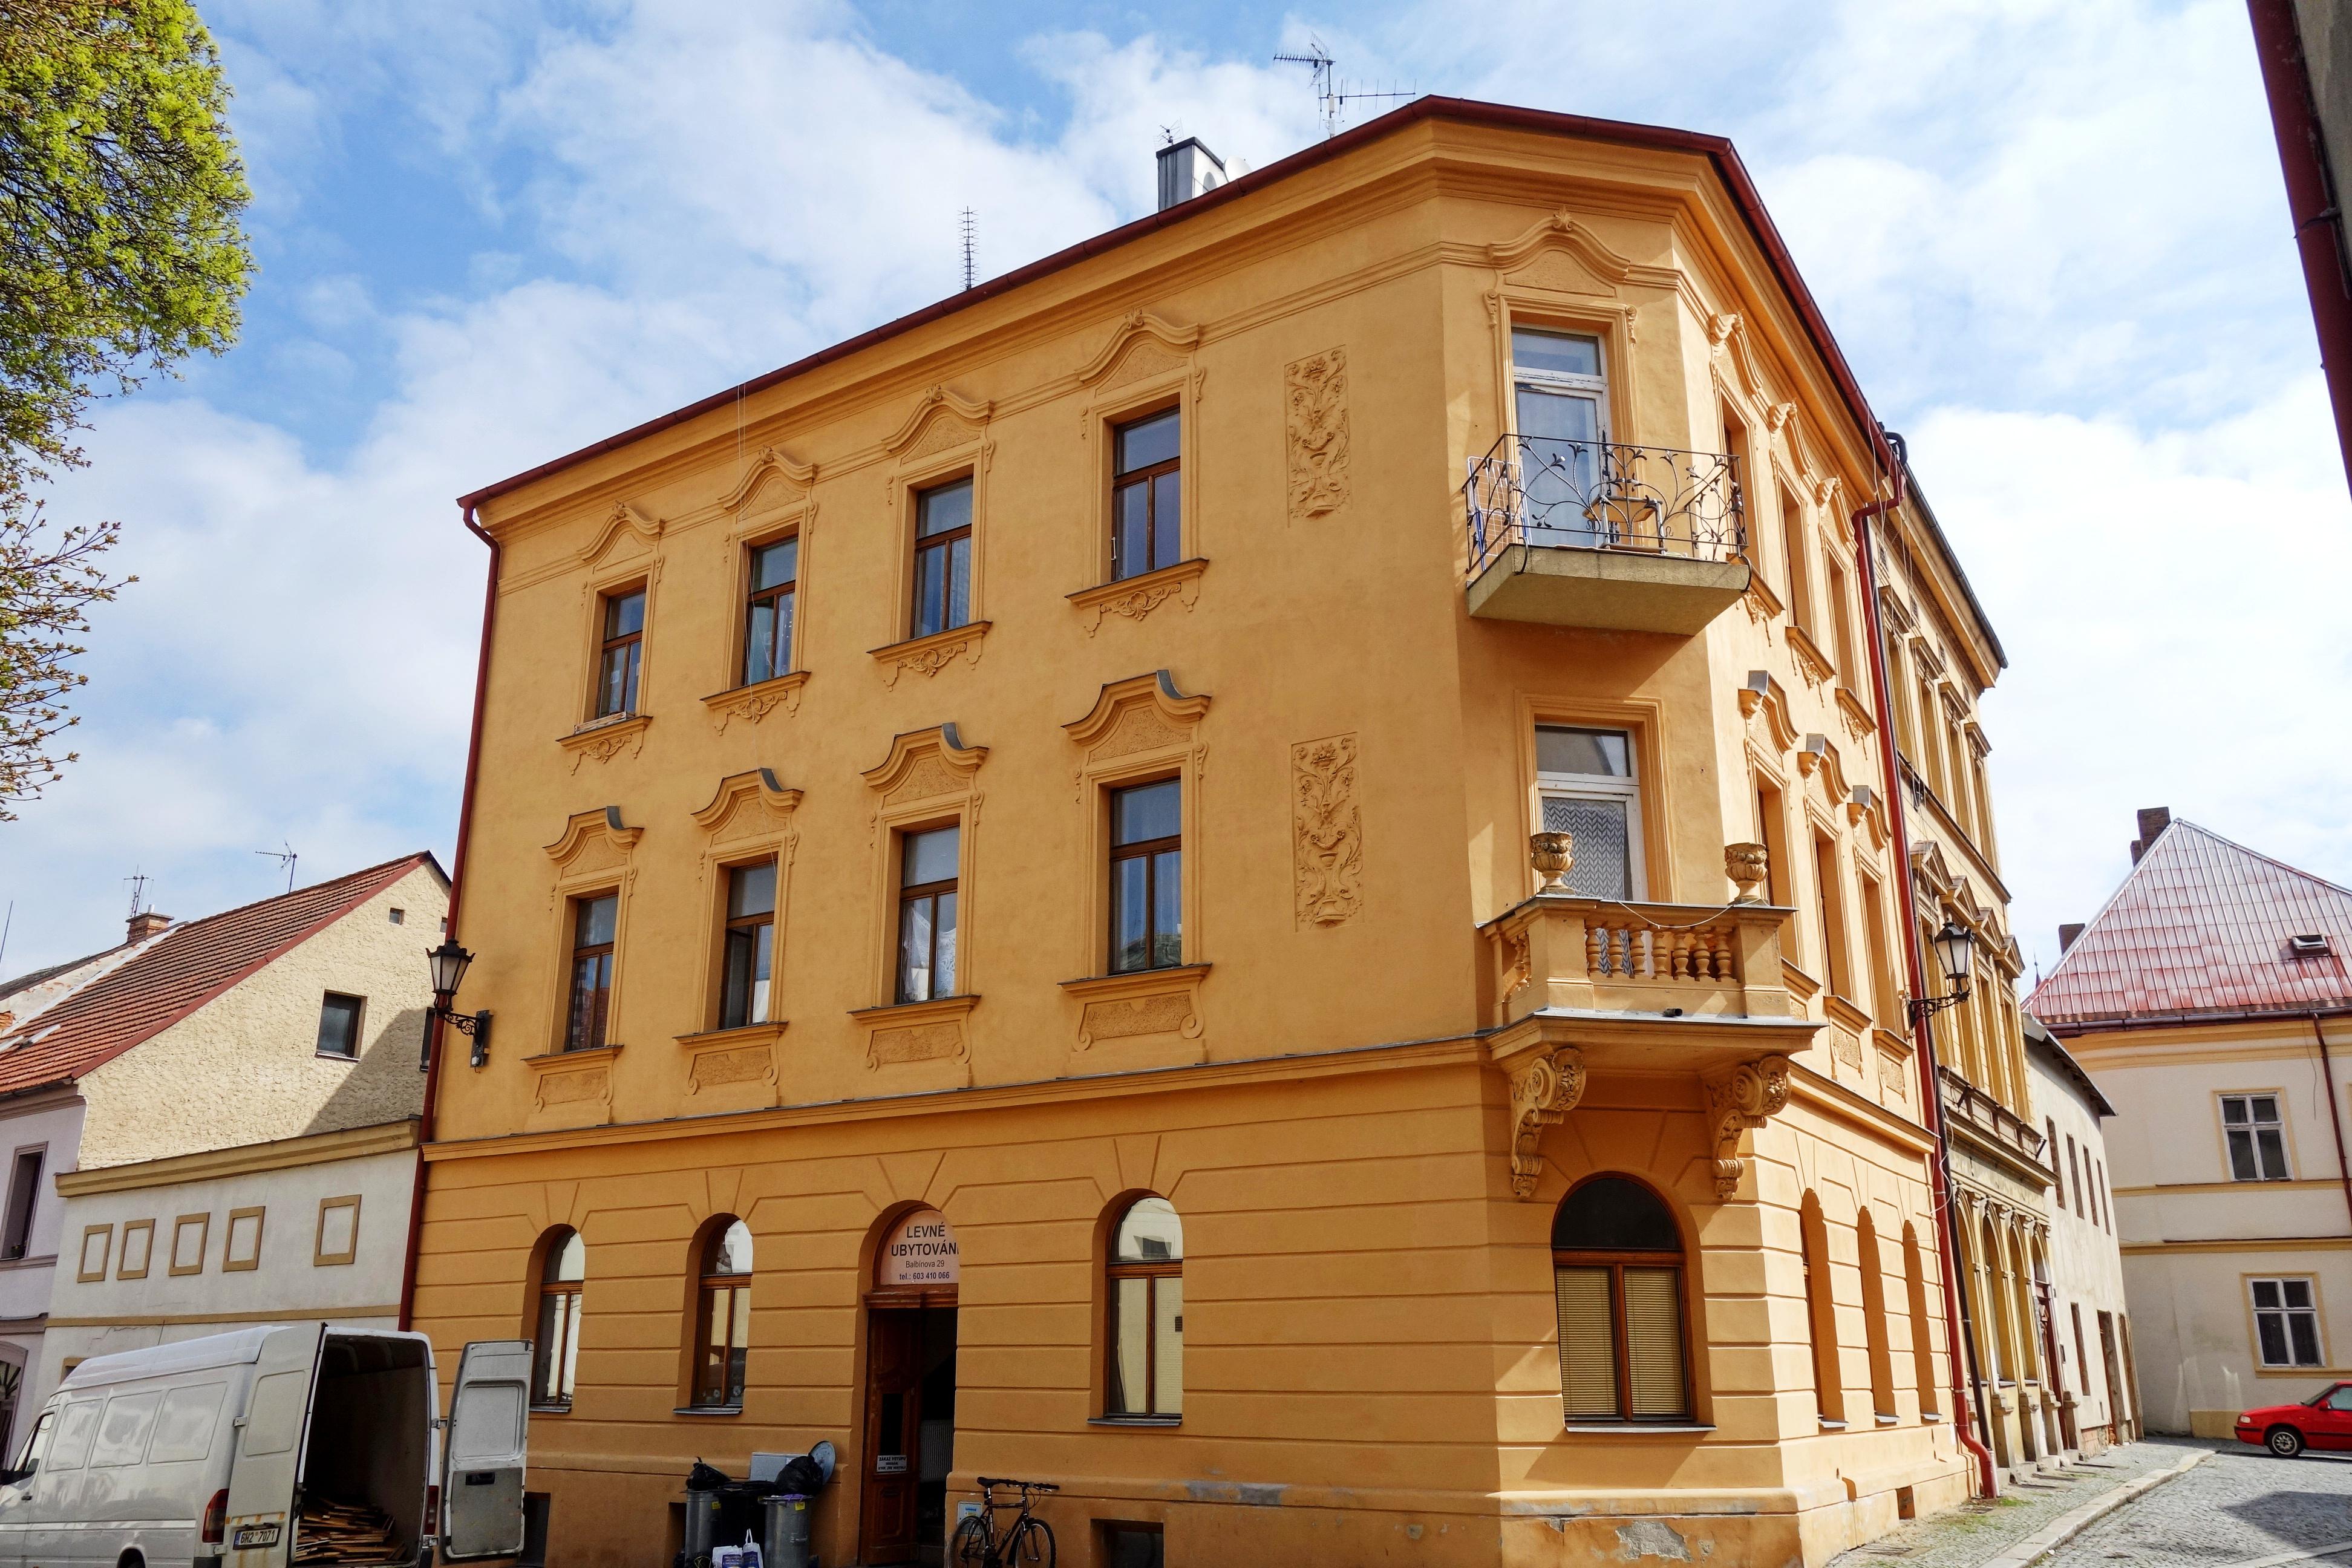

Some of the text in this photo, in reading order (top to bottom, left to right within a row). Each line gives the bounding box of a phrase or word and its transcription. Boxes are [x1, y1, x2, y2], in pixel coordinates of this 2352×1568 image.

[906, 1221, 945, 1238] LEVNÉ
[891, 1239, 959, 1256] UBYTOVÁN
[240, 1529, 276, 1544] 6H2 7071
